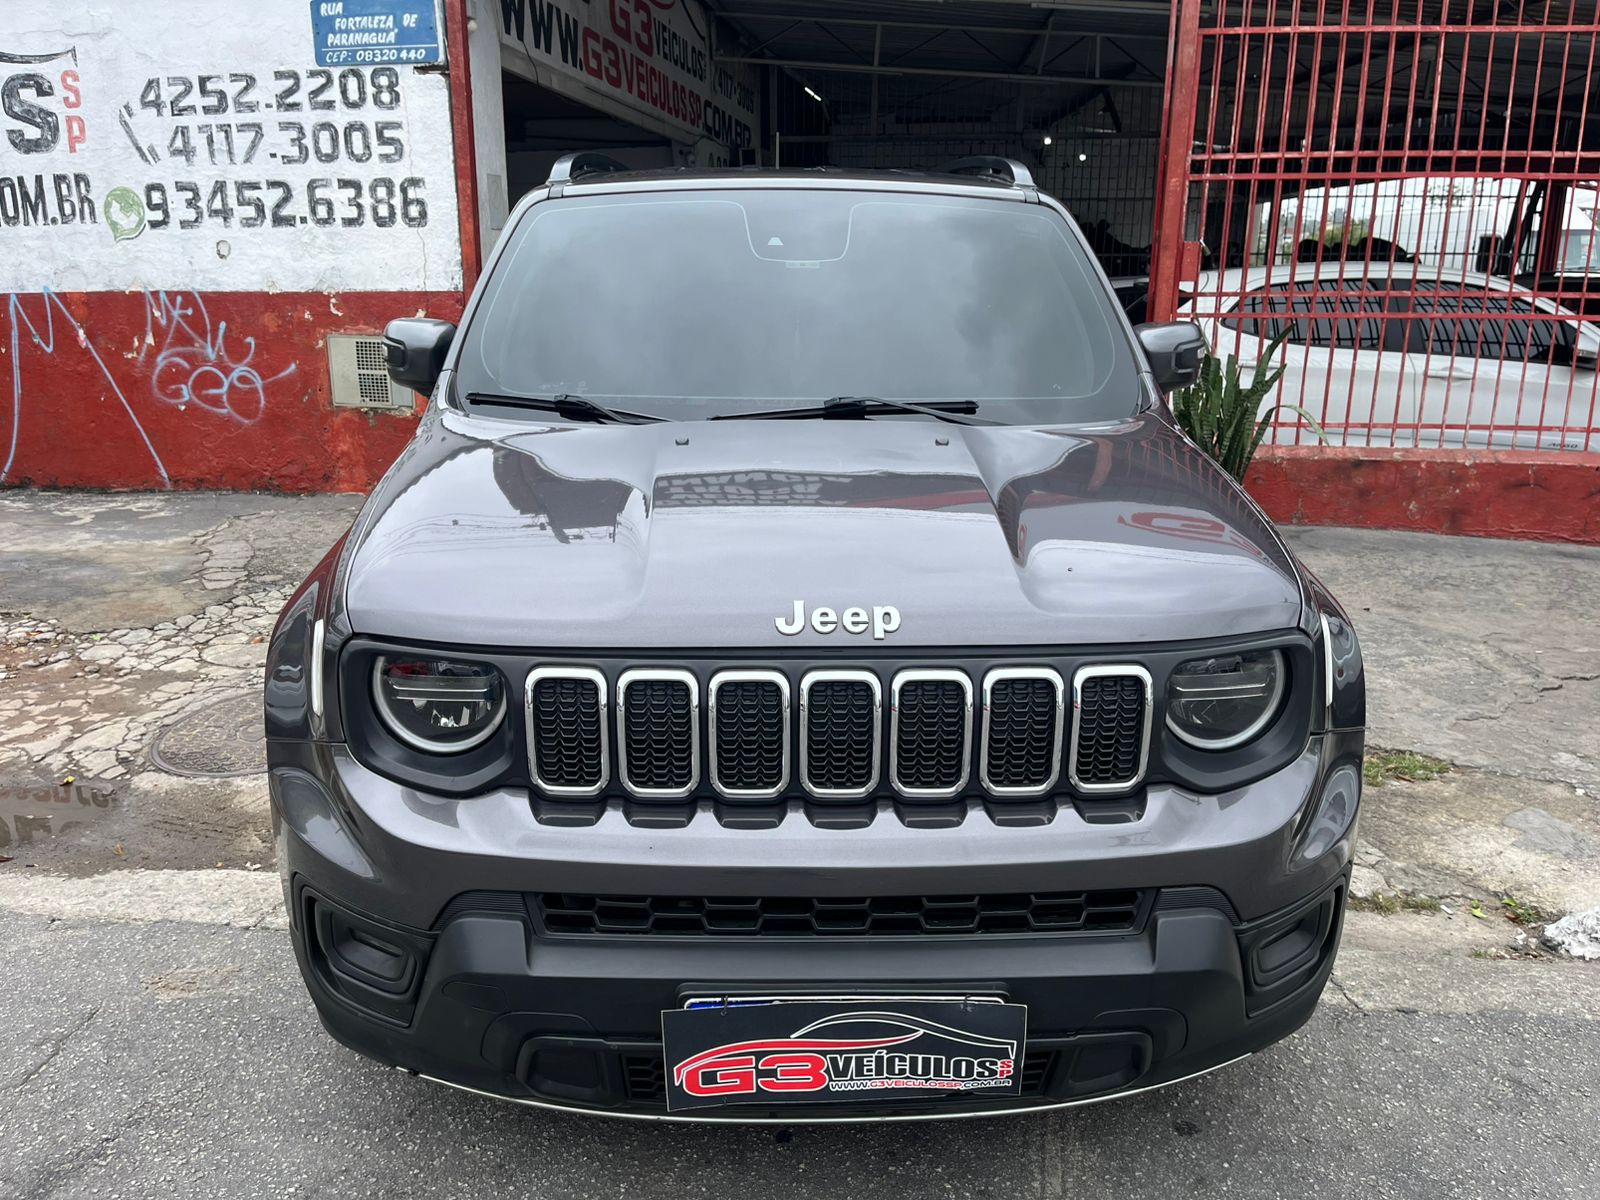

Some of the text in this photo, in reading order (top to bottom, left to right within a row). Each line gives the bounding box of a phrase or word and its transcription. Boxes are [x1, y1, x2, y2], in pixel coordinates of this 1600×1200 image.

[320, 2, 343, 16] RUA
[334, 13, 418, 31] FORTALEZA DE
[325, 51, 352, 63] CEP:
[139, 66, 401, 118] 4252.2208
[166, 120, 404, 166] 4117.3005
[0, 172, 98, 228] OM.BR
[144, 176, 429, 230] 93452.6386
[774, 600, 901, 640] Jeep
